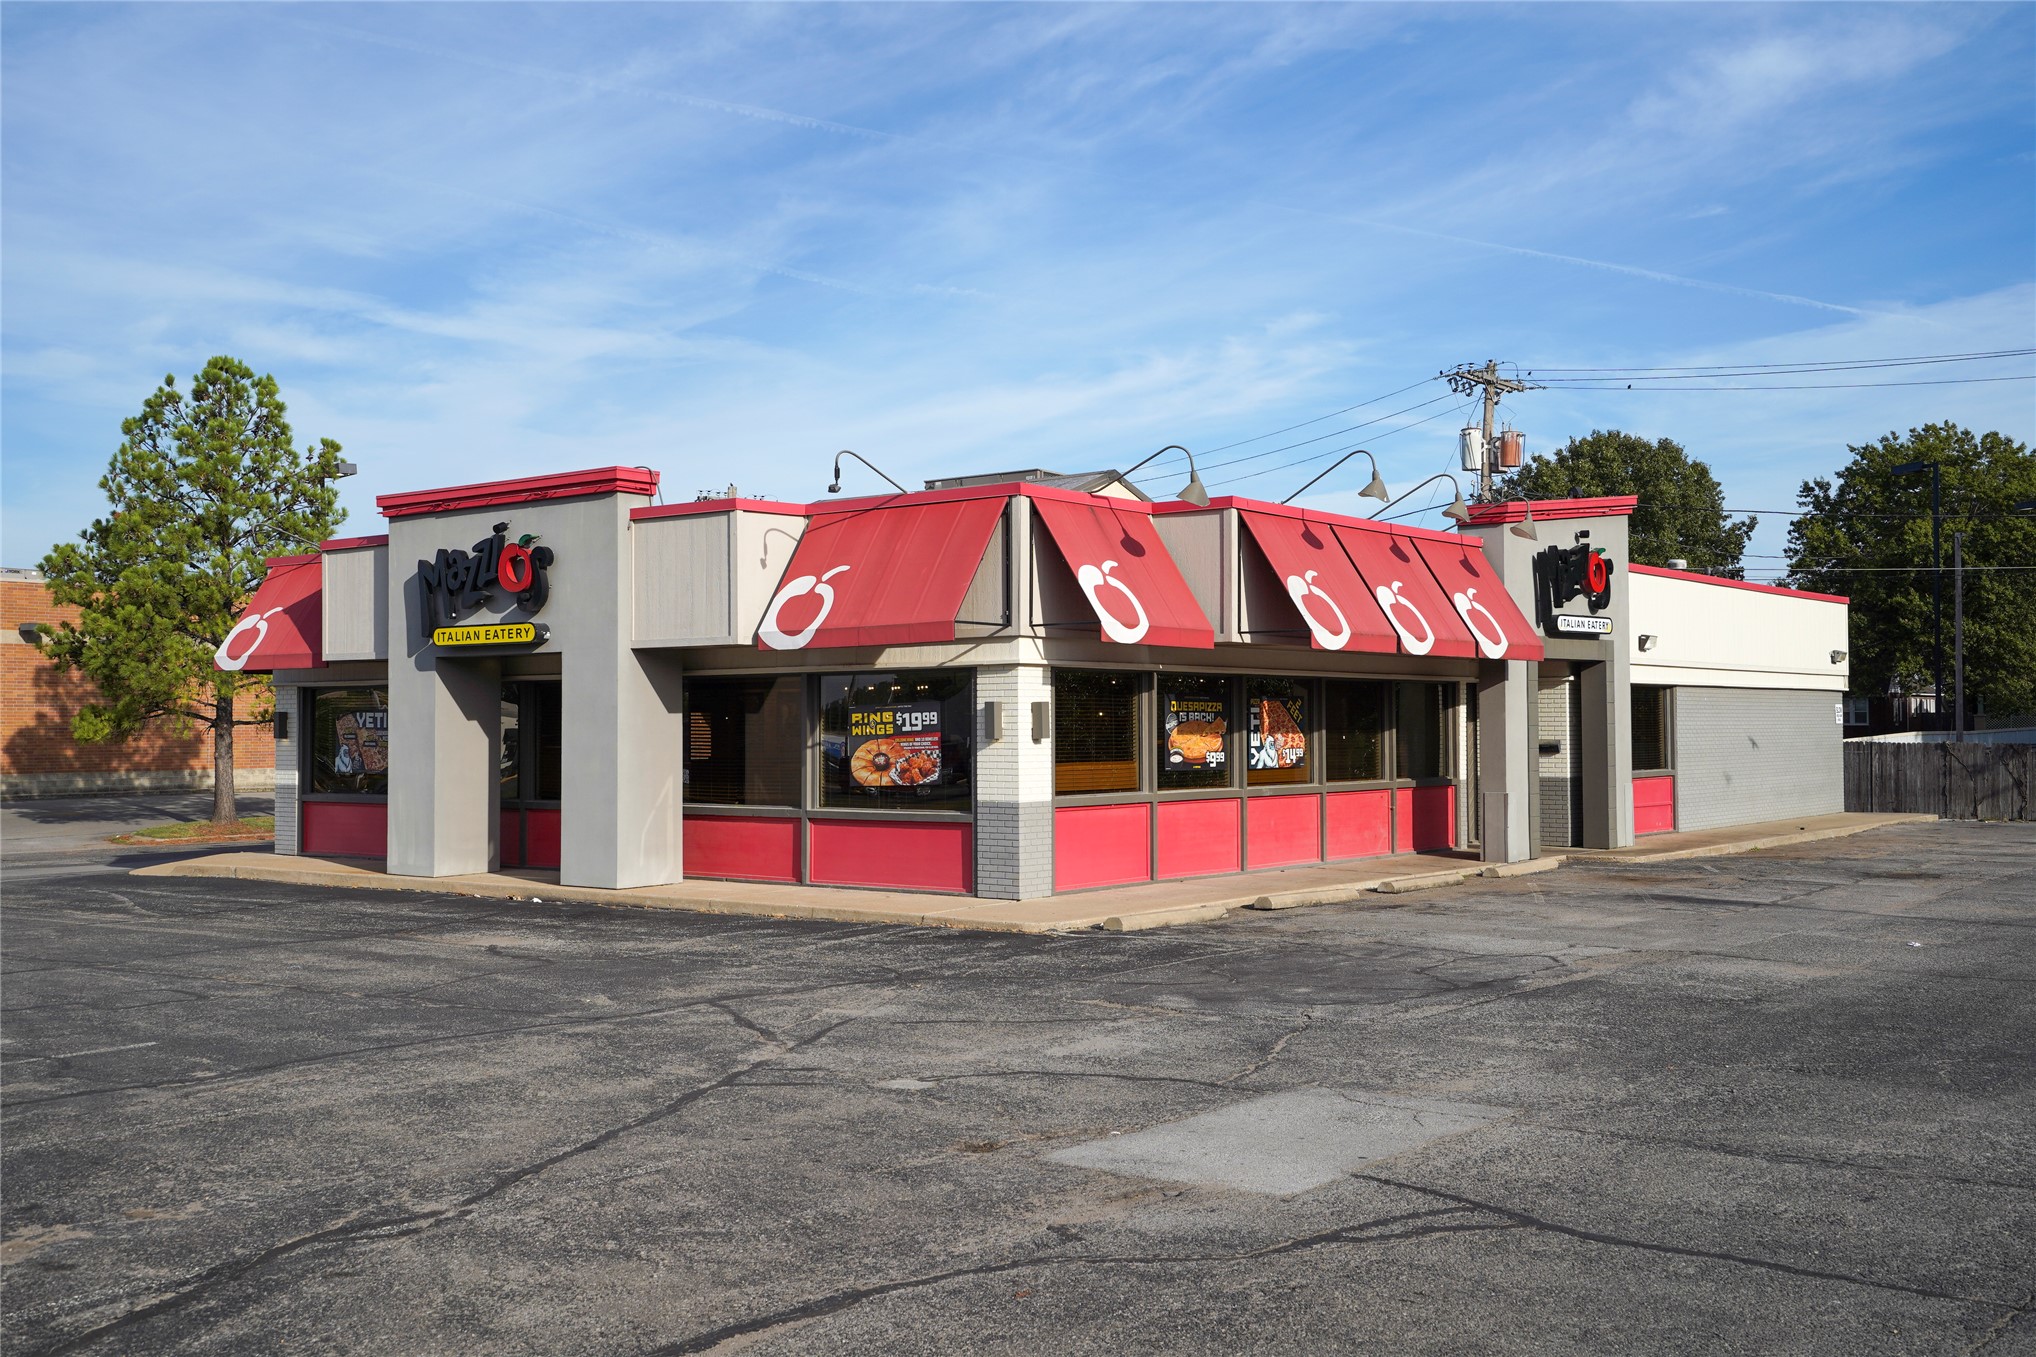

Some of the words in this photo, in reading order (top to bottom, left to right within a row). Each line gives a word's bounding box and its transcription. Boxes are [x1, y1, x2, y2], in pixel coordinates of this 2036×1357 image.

[1560, 618, 1585, 629] ITALIAN
[1588, 620, 1609, 630] EATERY
[437, 630, 480, 643] ITALIAN
[485, 627, 530, 640] EATERY
[1171, 701, 1223, 712] QUESAPIZZA
[1286, 700, 1303, 723] FEET
[356, 712, 387, 728] YETI
[851, 711, 893, 723] RING
[1180, 713, 1187, 722] IS
[1188, 712, 1215, 722] BACK!
[851, 724, 893, 736] WINGS
[1251, 707, 1260, 765] YETI
